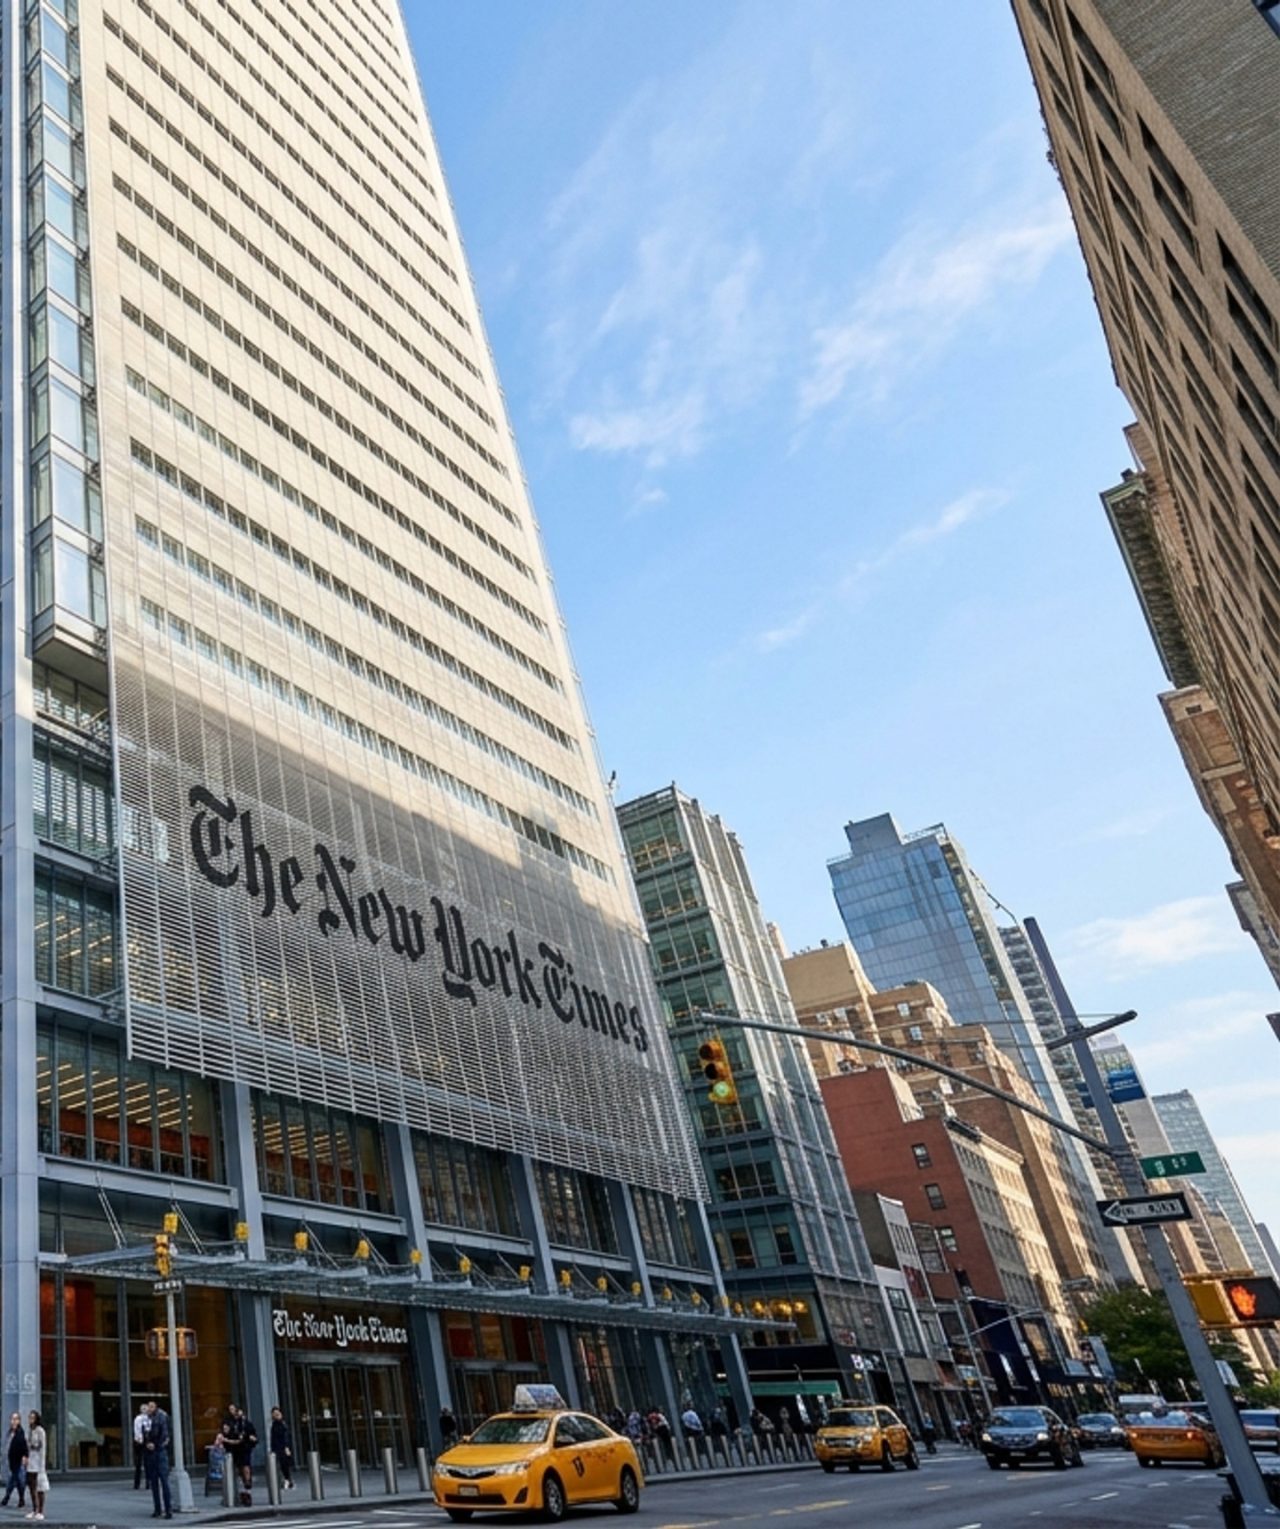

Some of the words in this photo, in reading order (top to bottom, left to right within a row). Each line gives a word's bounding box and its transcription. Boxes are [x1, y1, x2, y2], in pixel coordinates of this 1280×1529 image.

[189, 784, 305, 918] The
[314, 843, 426, 963] New
[430, 896, 543, 1009] York
[538, 941, 648, 1052] Times
